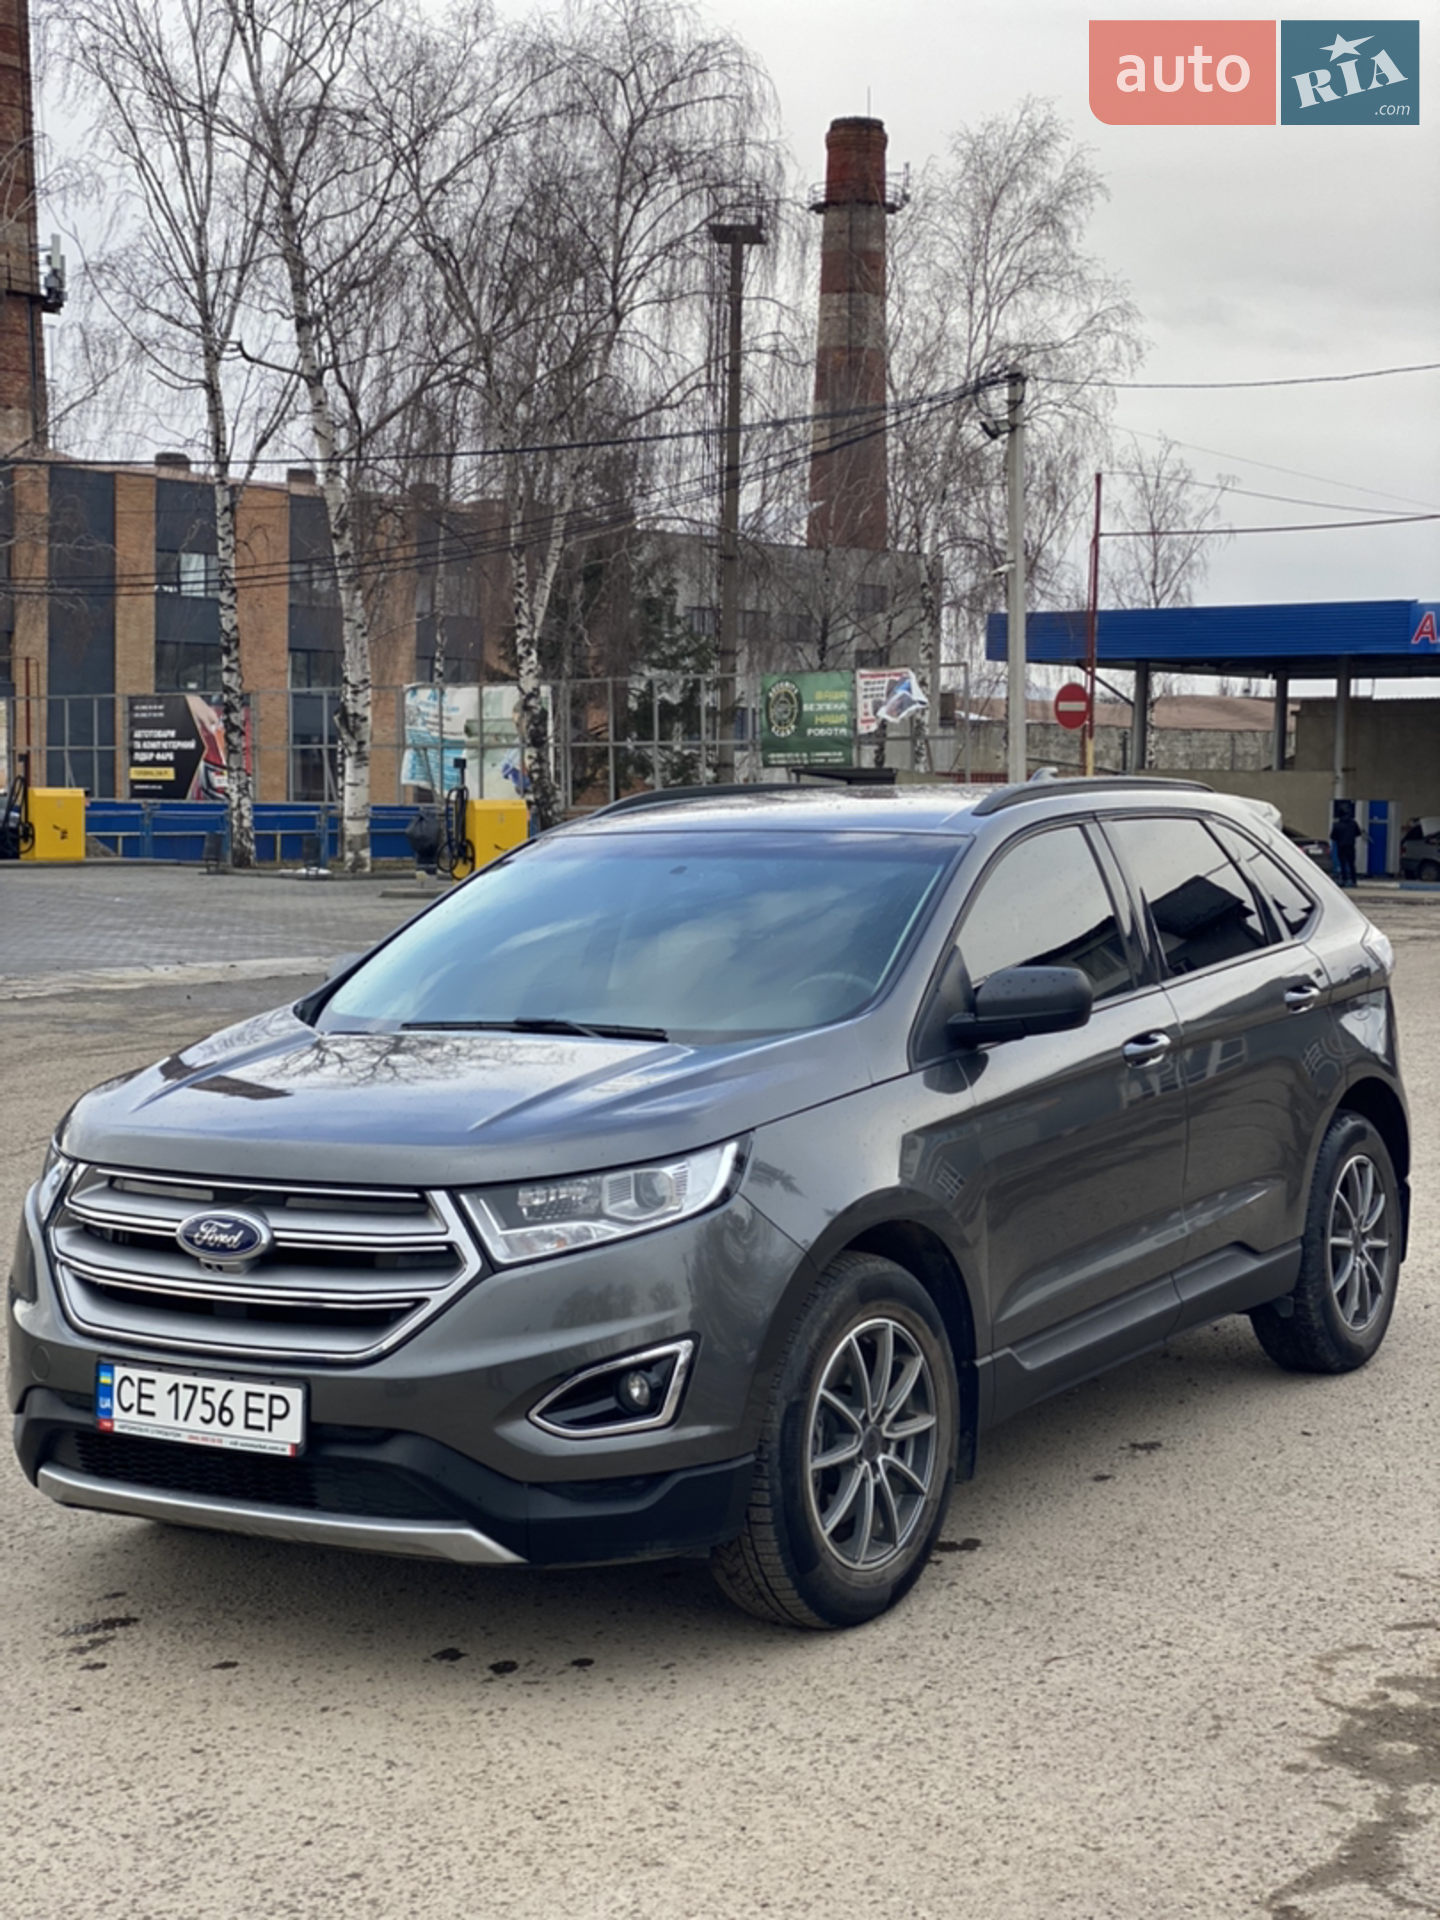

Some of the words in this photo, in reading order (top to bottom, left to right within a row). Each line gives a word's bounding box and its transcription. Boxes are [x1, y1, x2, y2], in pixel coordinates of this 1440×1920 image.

[193, 1220, 245, 1249] Ford
[117, 1375, 156, 1417] CE
[167, 1382, 235, 1428] 1756
[243, 1390, 291, 1433] EP
